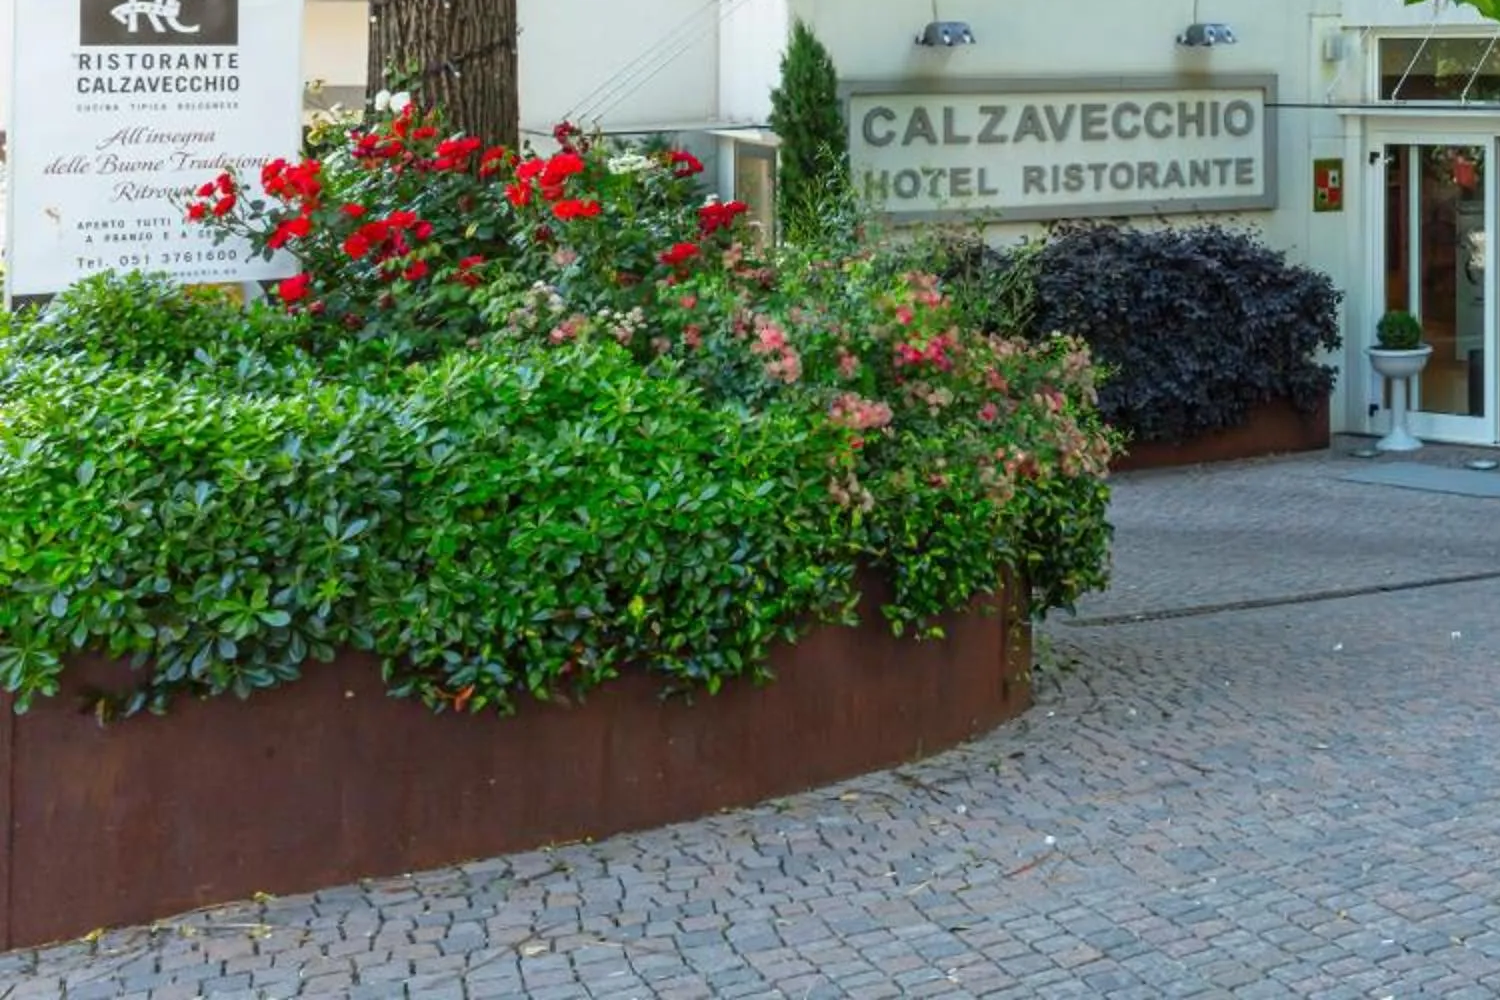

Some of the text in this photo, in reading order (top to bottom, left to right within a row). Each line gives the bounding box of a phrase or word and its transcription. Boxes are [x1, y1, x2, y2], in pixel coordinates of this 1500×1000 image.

[79, 53, 239, 70] RISTORANTE
[77, 75, 240, 94] CALZAVECCHIO
[862, 100, 1255, 147] CALZAVECCHIO
[95, 127, 215, 150] All'insegna
[43, 151, 270, 175] delle Buone Tradizioni
[864, 158, 1255, 200] HOTEL RISTORANTE
[77, 257, 109, 268] Tel.
[119, 255, 150, 267] 051
